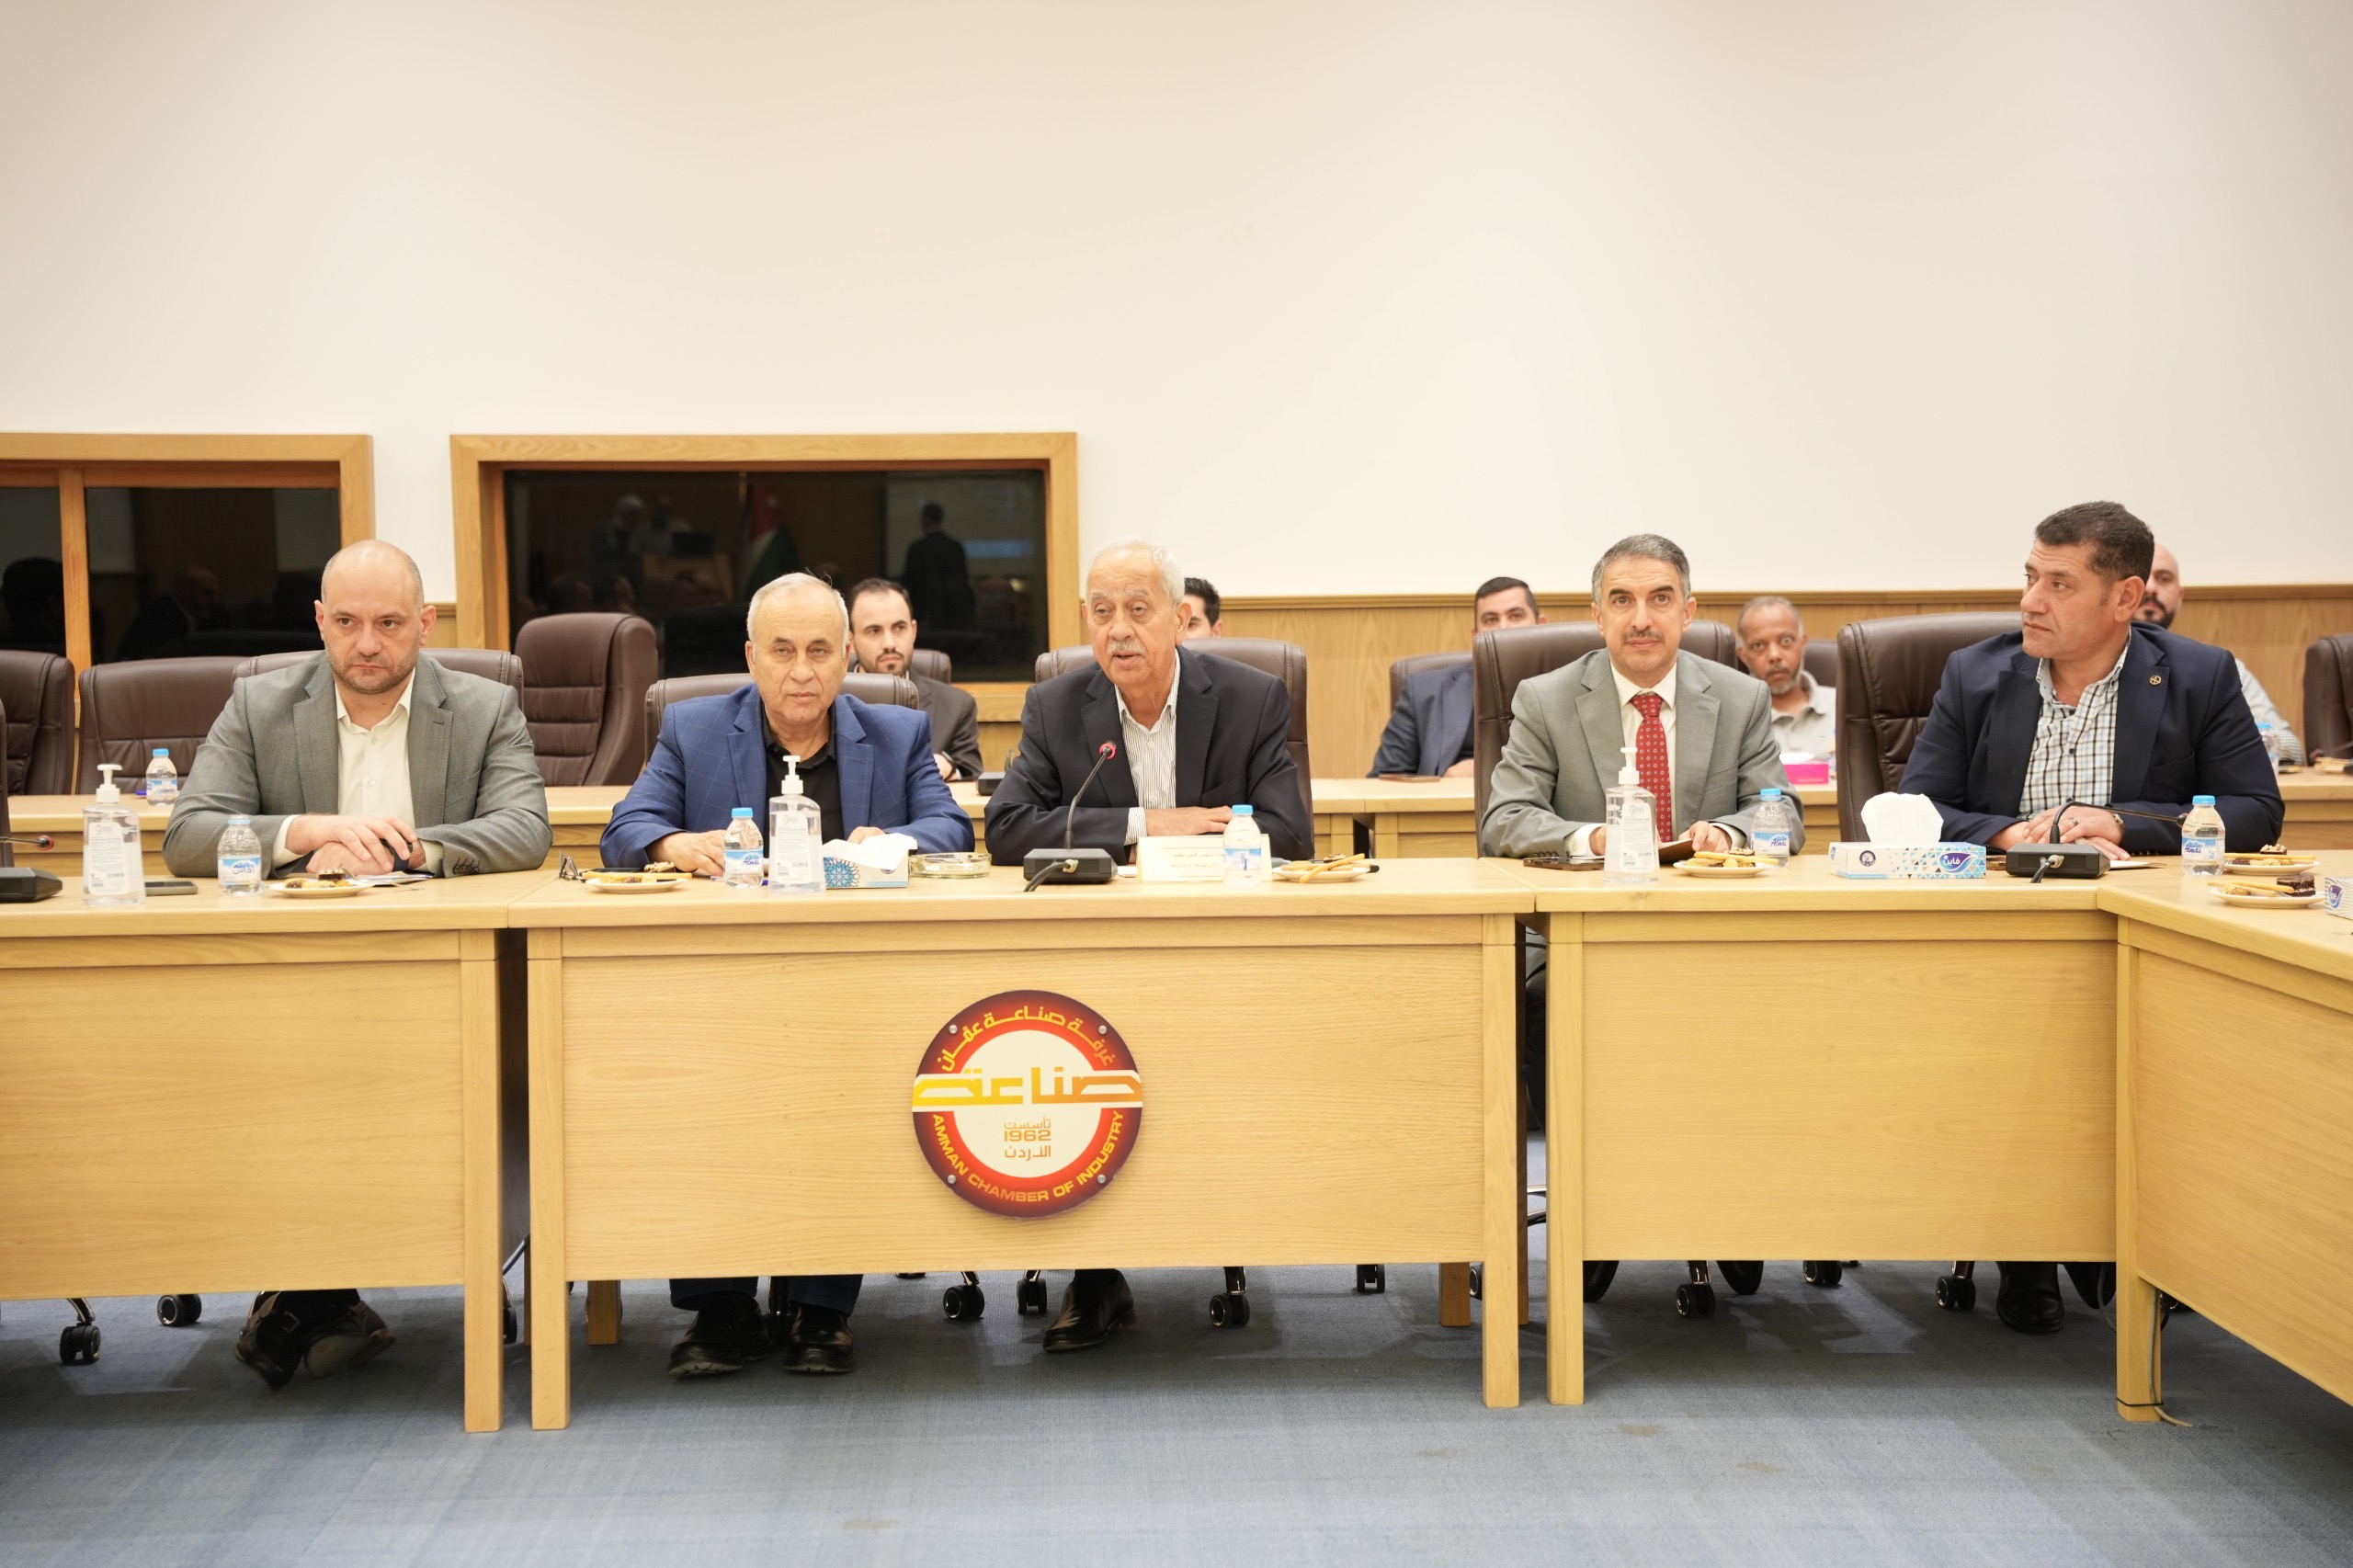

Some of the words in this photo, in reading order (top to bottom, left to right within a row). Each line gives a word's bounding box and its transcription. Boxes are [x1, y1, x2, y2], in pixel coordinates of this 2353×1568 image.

[1943, 855, 1961, 867] فاين
[983, 1006, 1066, 1029] صناعة
[1066, 1017, 1116, 1067] غرفة
[1004, 1116, 1051, 1130] تأسست
[1004, 1130, 1051, 1142] 1962
[932, 1114, 970, 1176] AMMAN
[968, 1173, 1050, 1203] CHAMBER
[1052, 1180, 1075, 1198] OF
[1076, 1110, 1124, 1186] INDUSTRY
